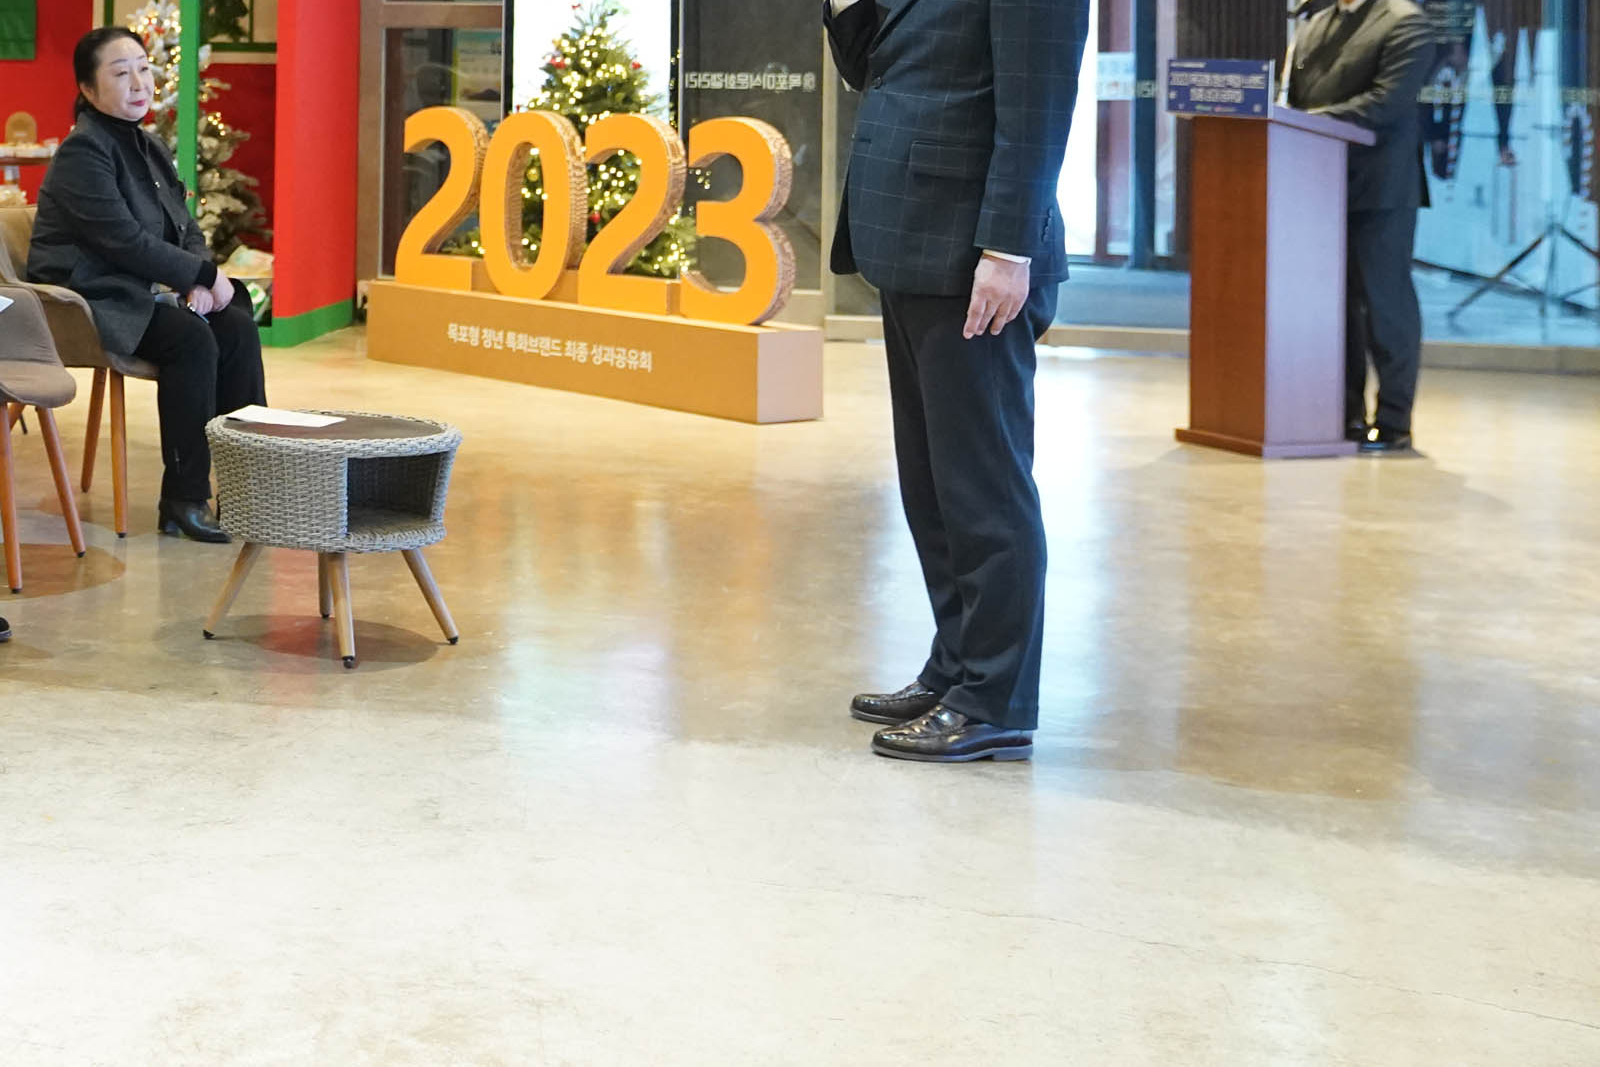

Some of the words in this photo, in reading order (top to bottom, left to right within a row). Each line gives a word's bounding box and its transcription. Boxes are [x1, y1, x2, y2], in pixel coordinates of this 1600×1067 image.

[395, 106, 796, 325] 2023
[448, 324, 479, 346] 목포형
[482, 329, 503, 349] 청년
[565, 341, 588, 362] 최종
[591, 345, 651, 372] 성과공유회
